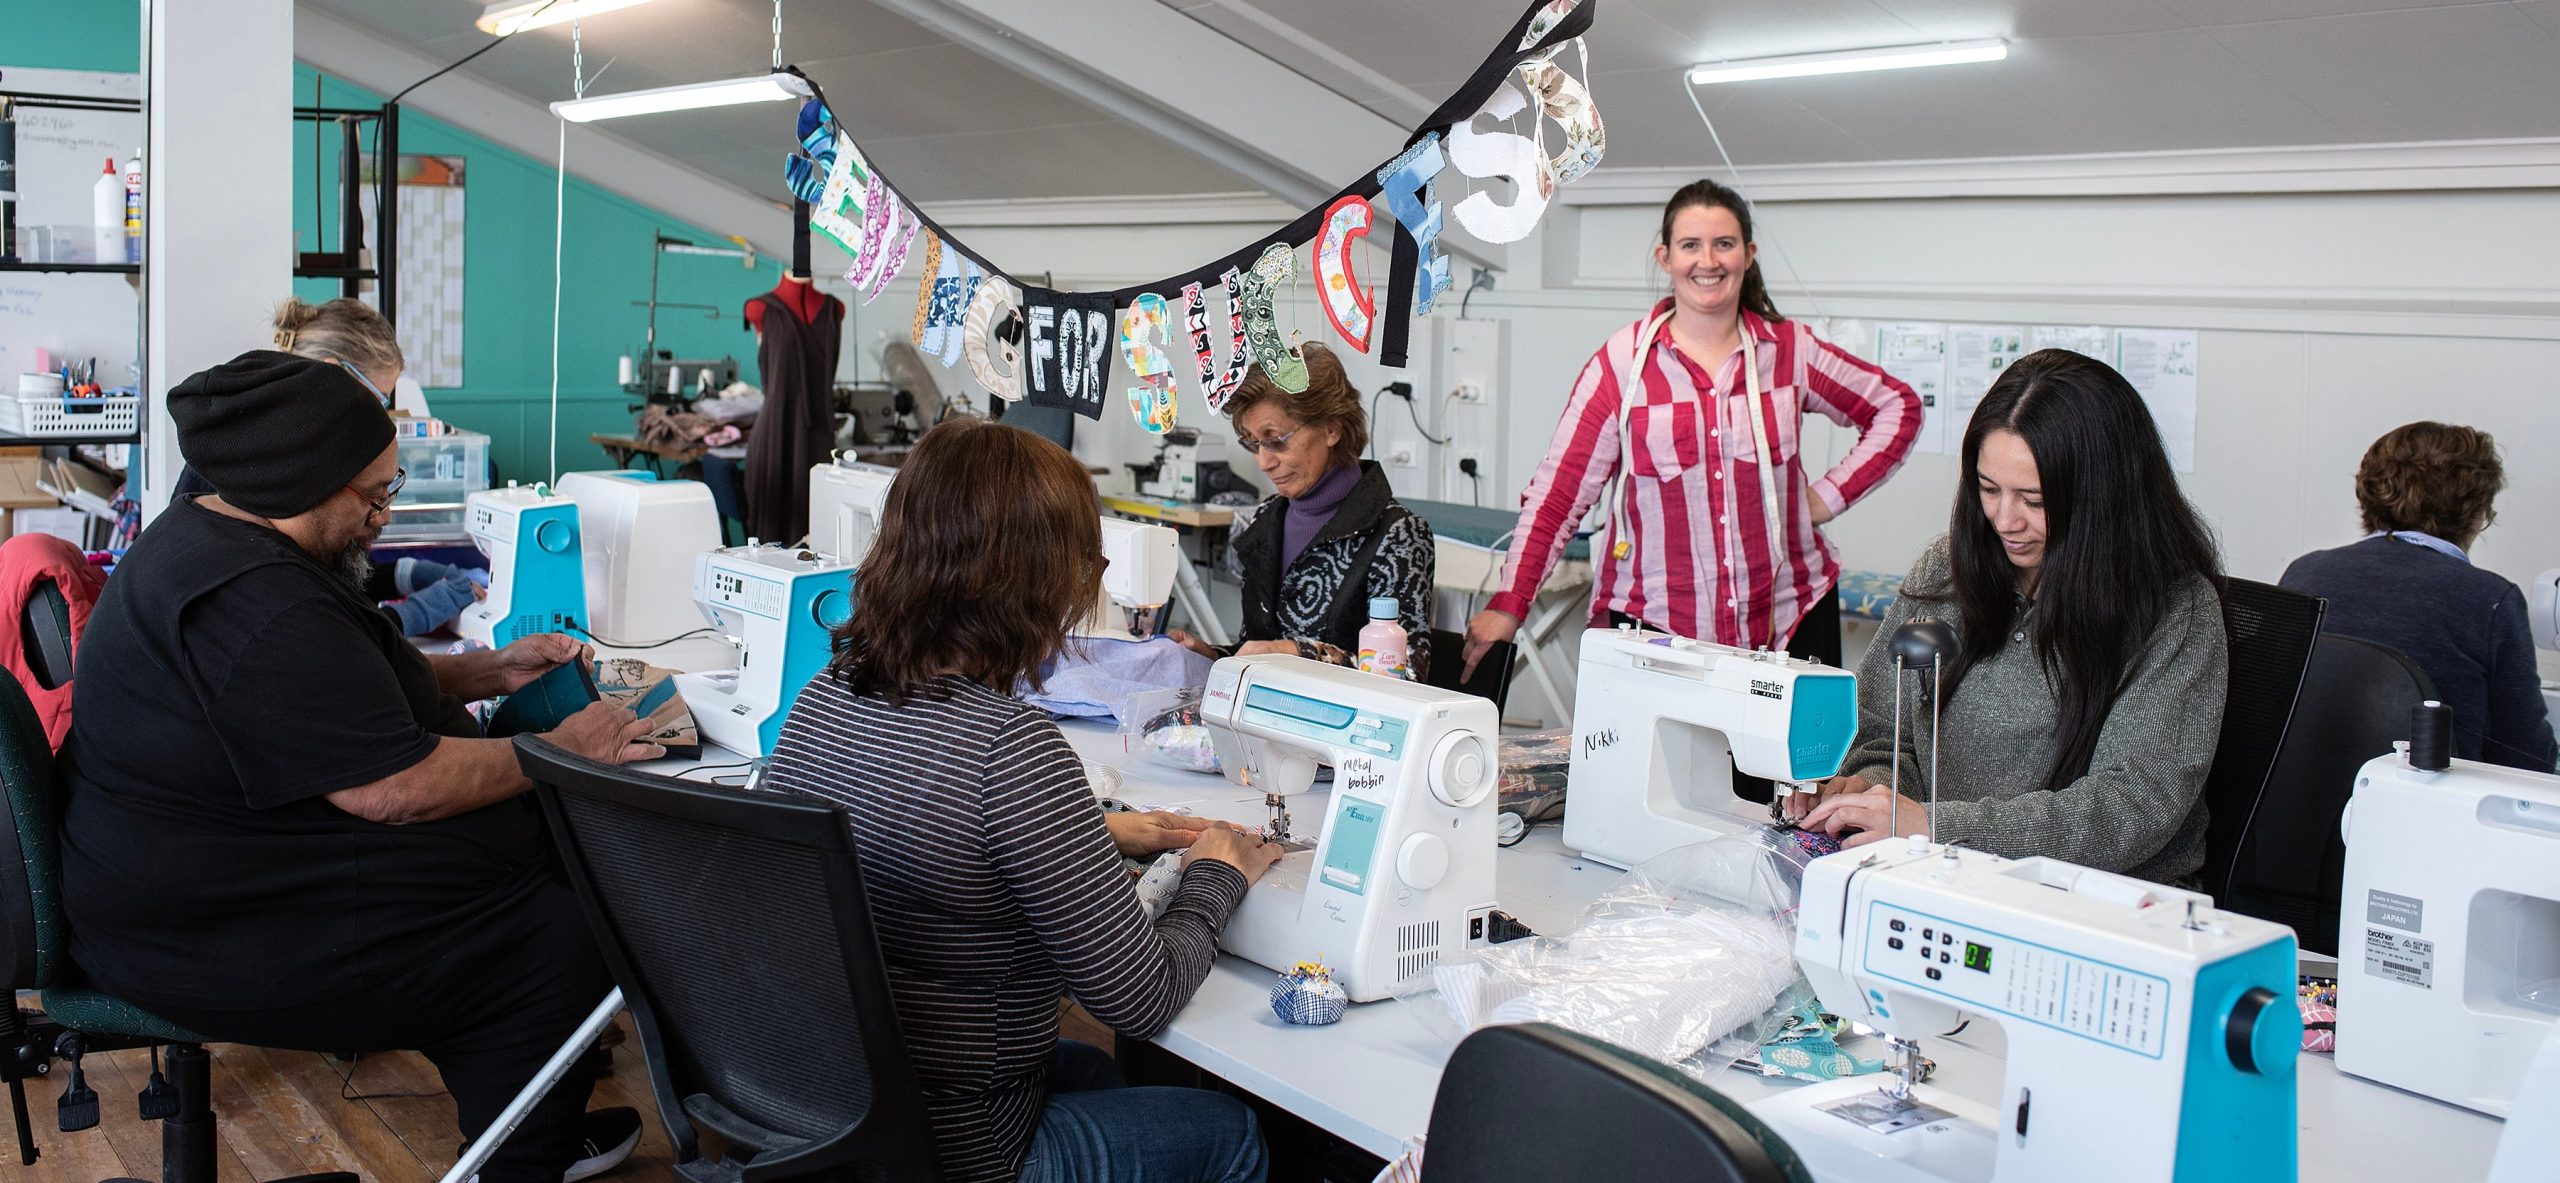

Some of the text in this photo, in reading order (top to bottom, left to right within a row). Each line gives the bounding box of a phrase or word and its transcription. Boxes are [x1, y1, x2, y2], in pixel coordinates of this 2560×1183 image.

[1027, 305, 1109, 405] FOR
[1750, 679, 1784, 693] smarter
[1209, 689, 1232, 701] JANOME
[1585, 728, 1619, 760] Nikki
[1348, 774, 1385, 790] bobbin
[2381, 913, 2406, 924] JAPAN
[2368, 929, 2394, 941] brother
[1965, 943, 1991, 970] 01
